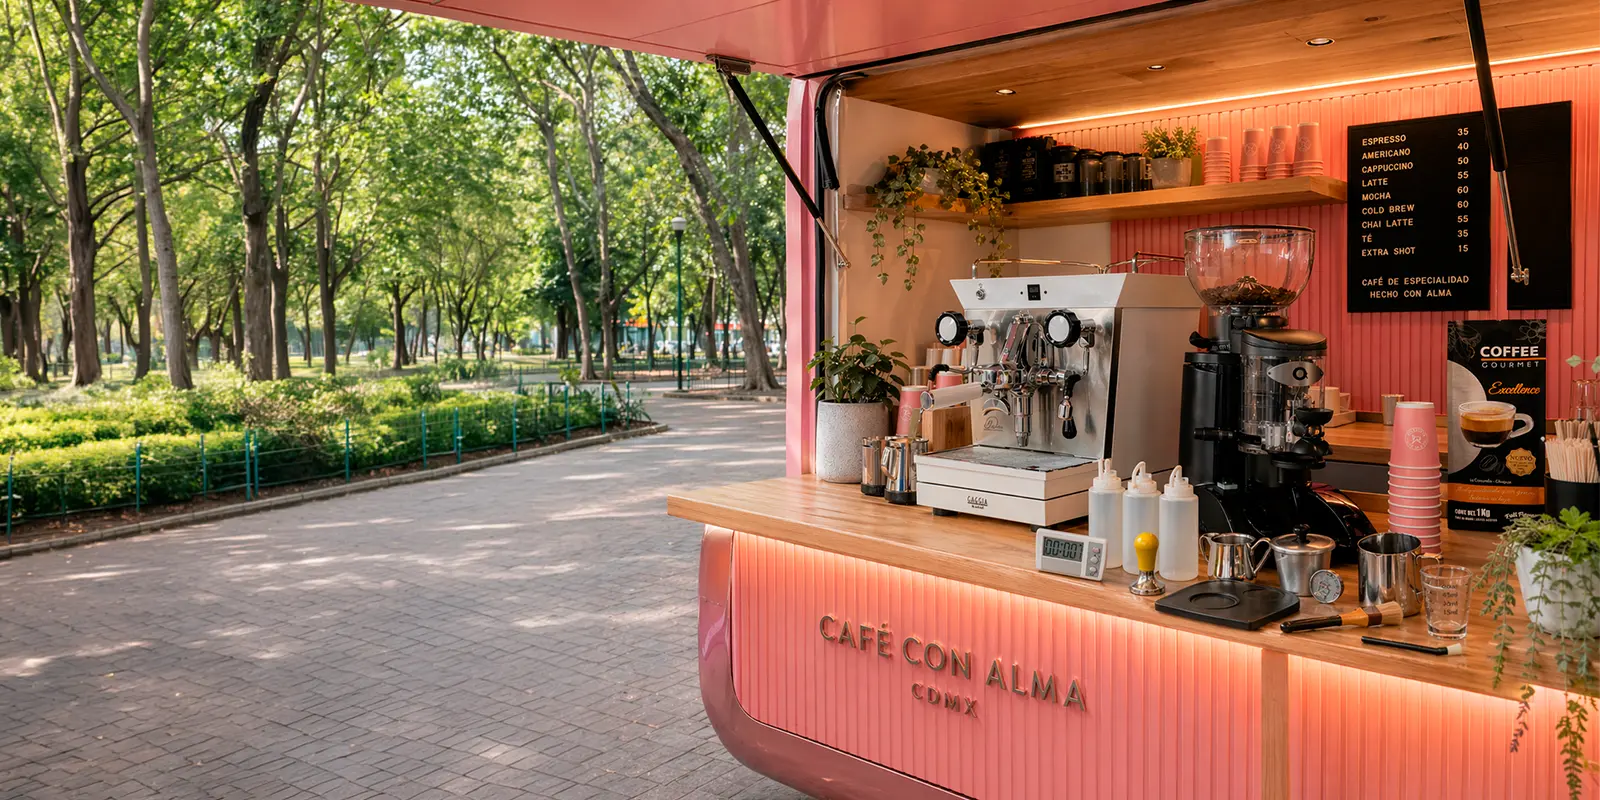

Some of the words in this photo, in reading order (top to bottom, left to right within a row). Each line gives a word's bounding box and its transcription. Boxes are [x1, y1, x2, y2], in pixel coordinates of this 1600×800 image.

[1363, 135, 1406, 146] ESPRESSO
[1458, 128, 1468, 136] 35
[1362, 148, 1410, 159] AMERICANO
[1458, 142, 1469, 150] 40
[1362, 162, 1413, 173] CAPPUCCINO
[1362, 178, 1387, 187] LATTE
[1458, 171, 1468, 179] 55
[1362, 192, 1391, 200] MOCHA
[1389, 204, 1414, 213] BREW
[1386, 219, 1413, 227] LATTE
[1458, 215, 1468, 223] 55
[1362, 234, 1372, 242] TÉ
[1394, 247, 1415, 255] SHOT
[1362, 277, 1383, 286] CAFÉ
[1404, 276, 1469, 284] ESPECIALIDAD
[1480, 346, 1538, 357] COFFEE
[1488, 381, 1541, 395] Excellence
[819, 613, 894, 659] CAFÉ
[902, 635, 972, 680] CON
[986, 658, 1088, 712] ALMA
[911, 682, 978, 718] CDMX
